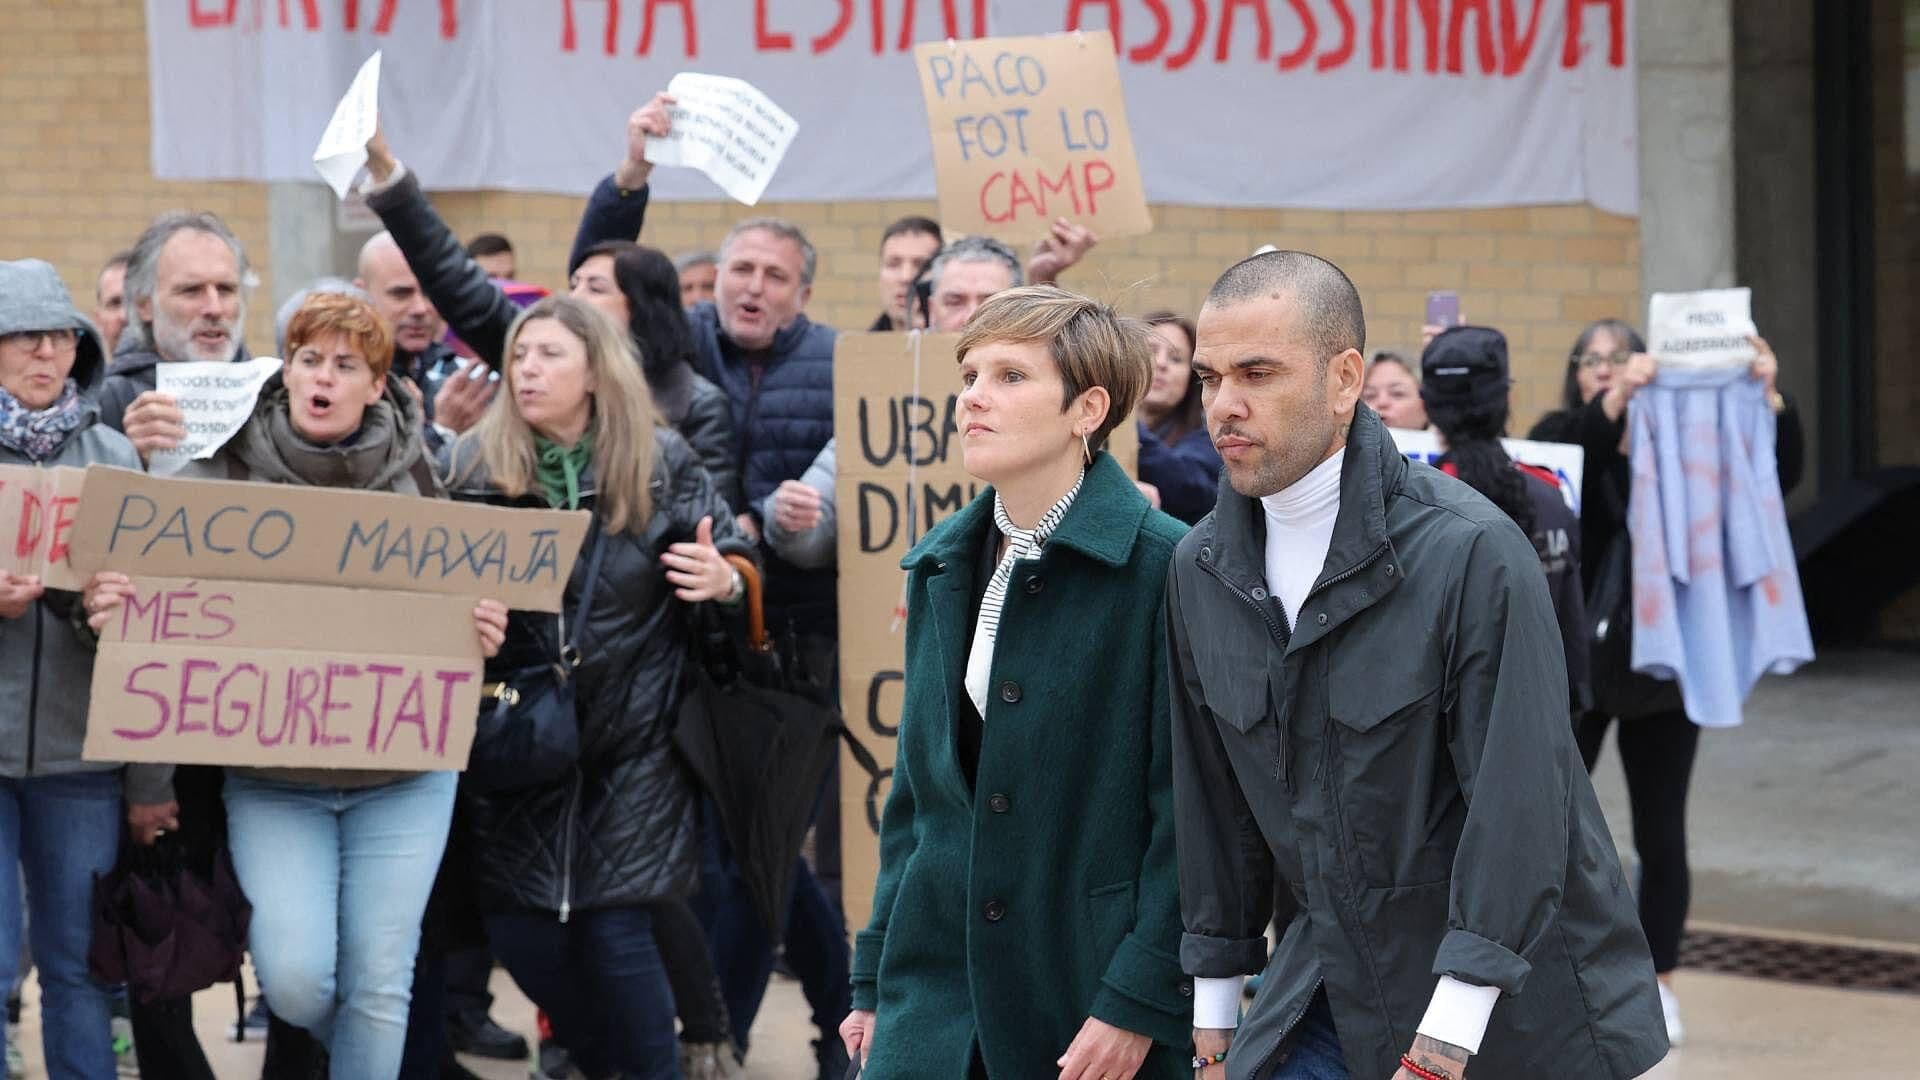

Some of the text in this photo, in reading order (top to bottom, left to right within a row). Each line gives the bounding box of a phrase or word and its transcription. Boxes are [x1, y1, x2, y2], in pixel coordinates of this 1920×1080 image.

[930, 53, 1046, 98] PACO
[954, 107, 1110, 160] FOT LO
[979, 160, 1116, 223] CAMP
[108, 494, 295, 560] PACO
[119, 580, 237, 643] MÉS
[111, 660, 473, 757] SEGURETAT
